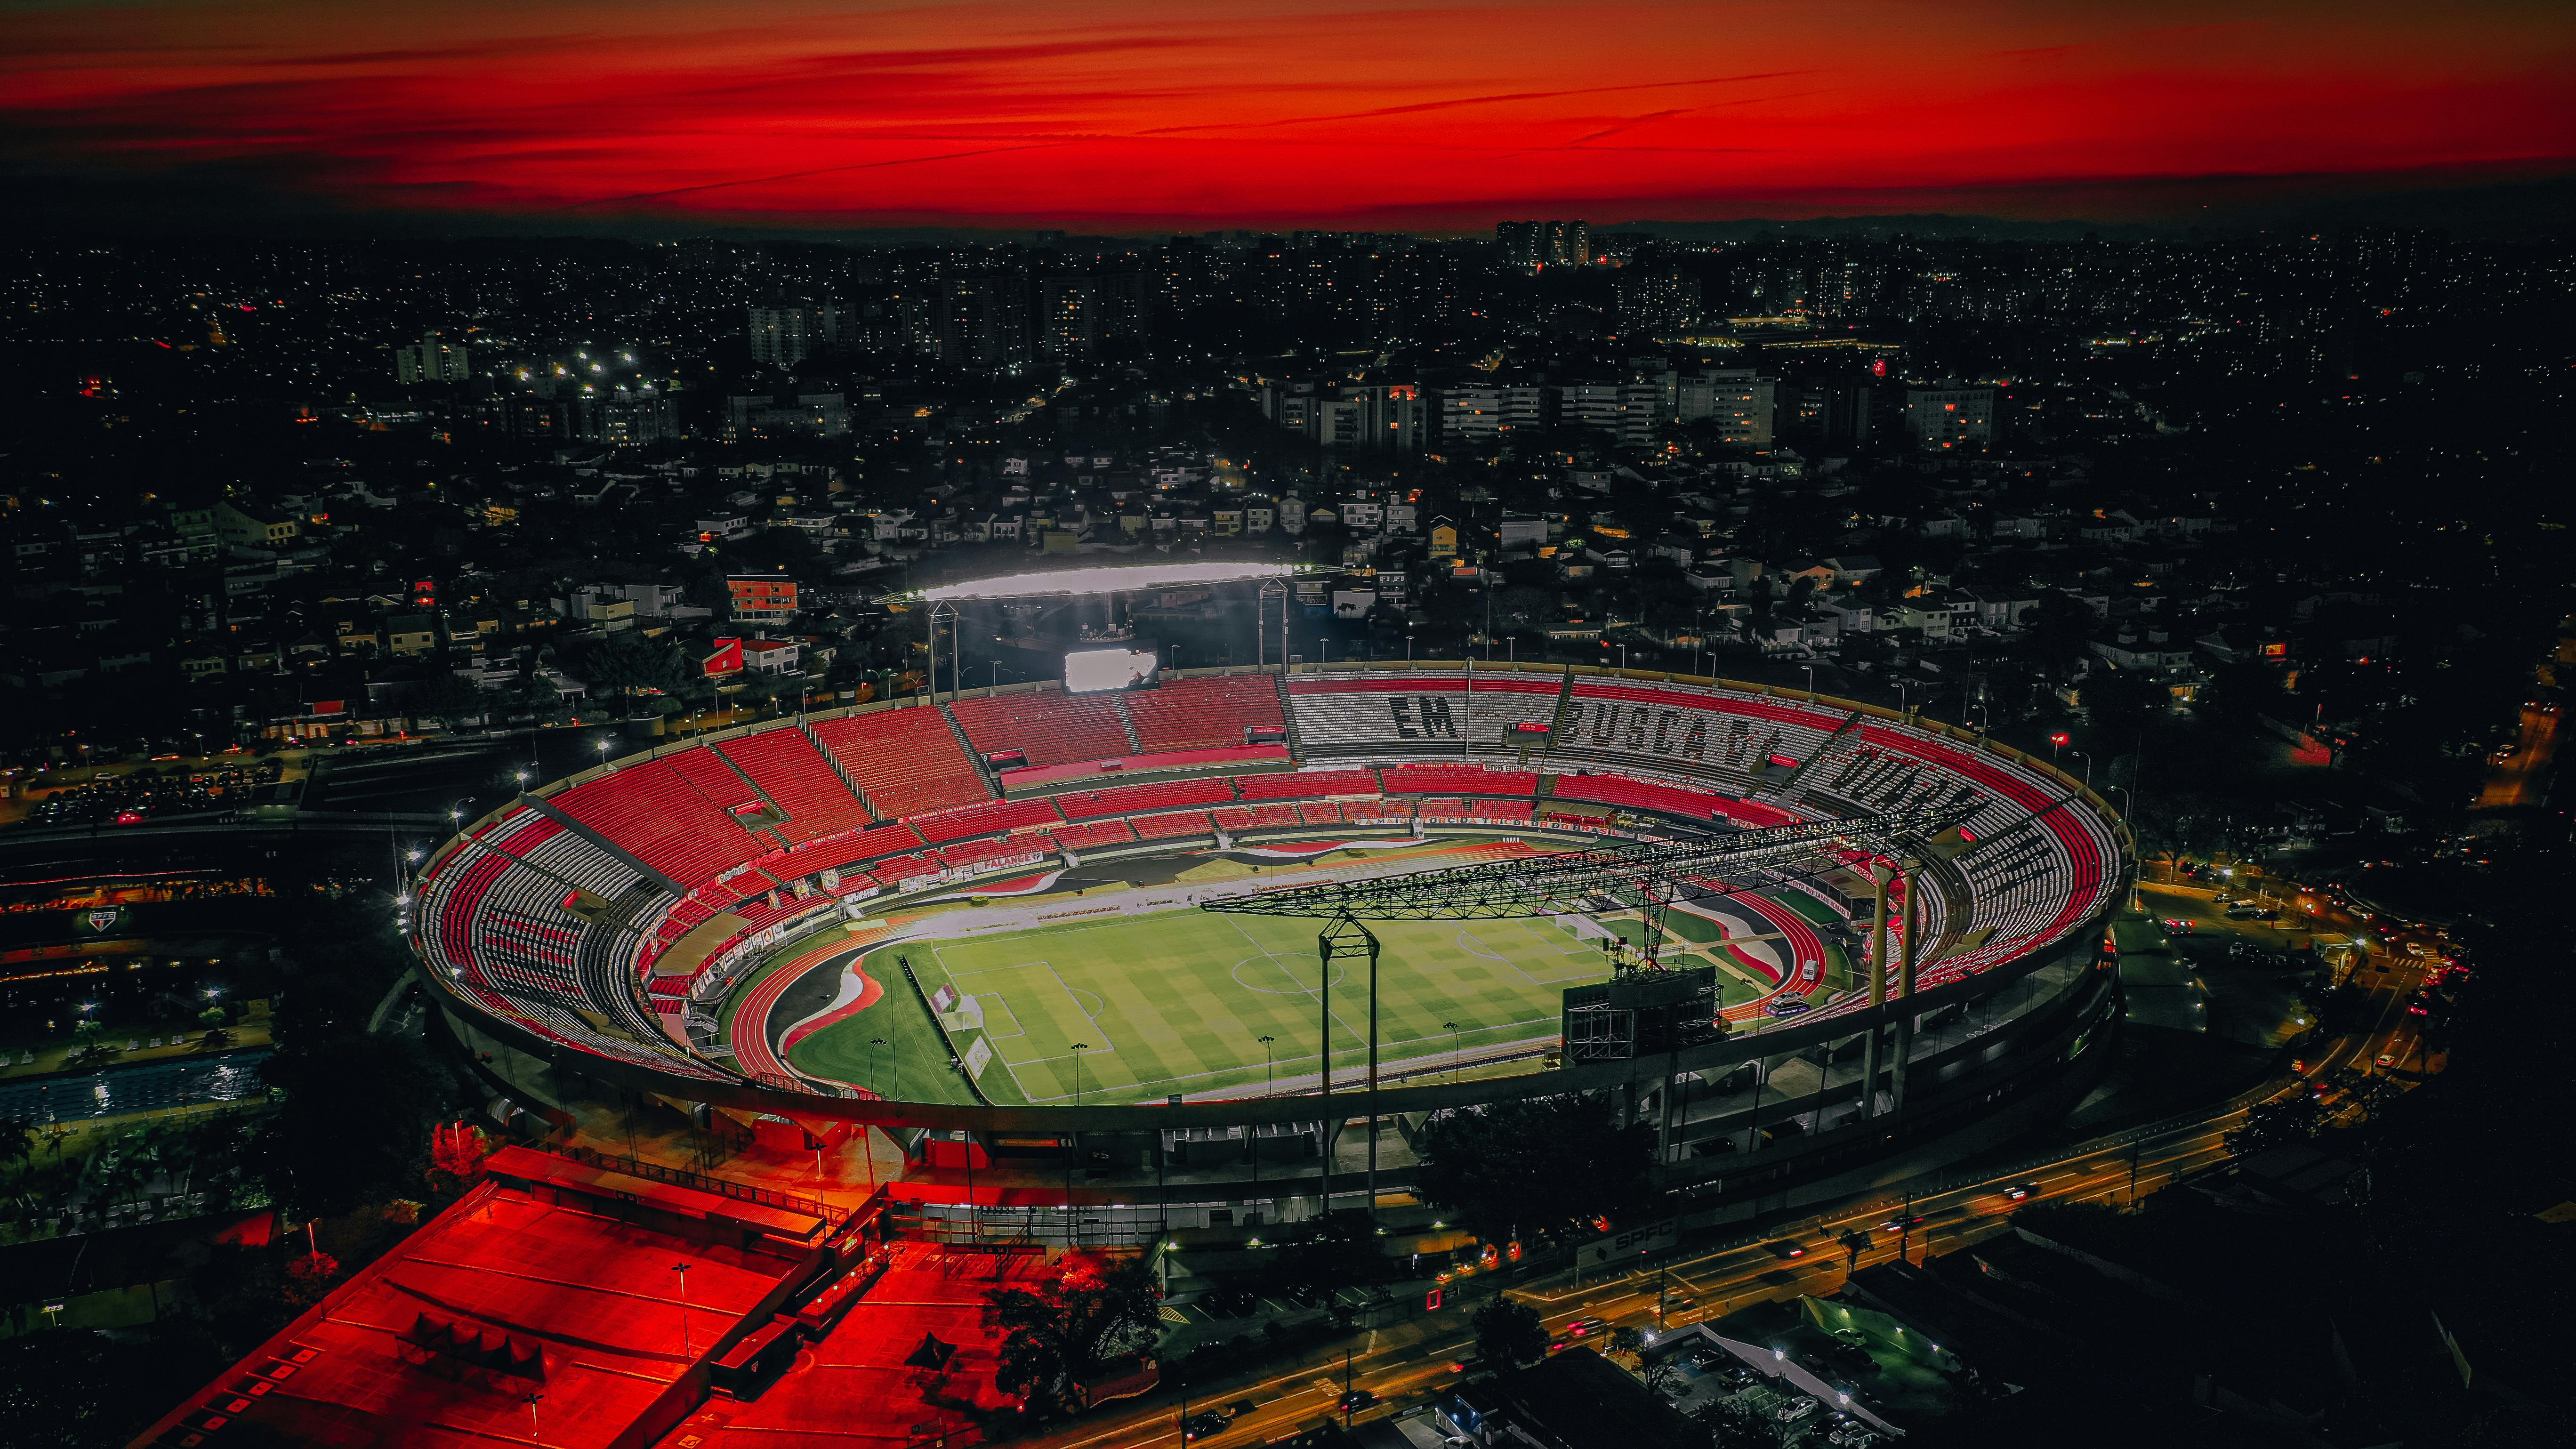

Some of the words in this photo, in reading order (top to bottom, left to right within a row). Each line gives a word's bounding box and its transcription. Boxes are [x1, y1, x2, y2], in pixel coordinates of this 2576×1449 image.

[1388, 697, 1457, 738] EM
[1558, 701, 1707, 758] BUSCA
[1482, 818, 1549, 828] TRICOLOR
[984, 853, 1031, 869] FALANGE
[1615, 1220, 1673, 1251] SPFC
